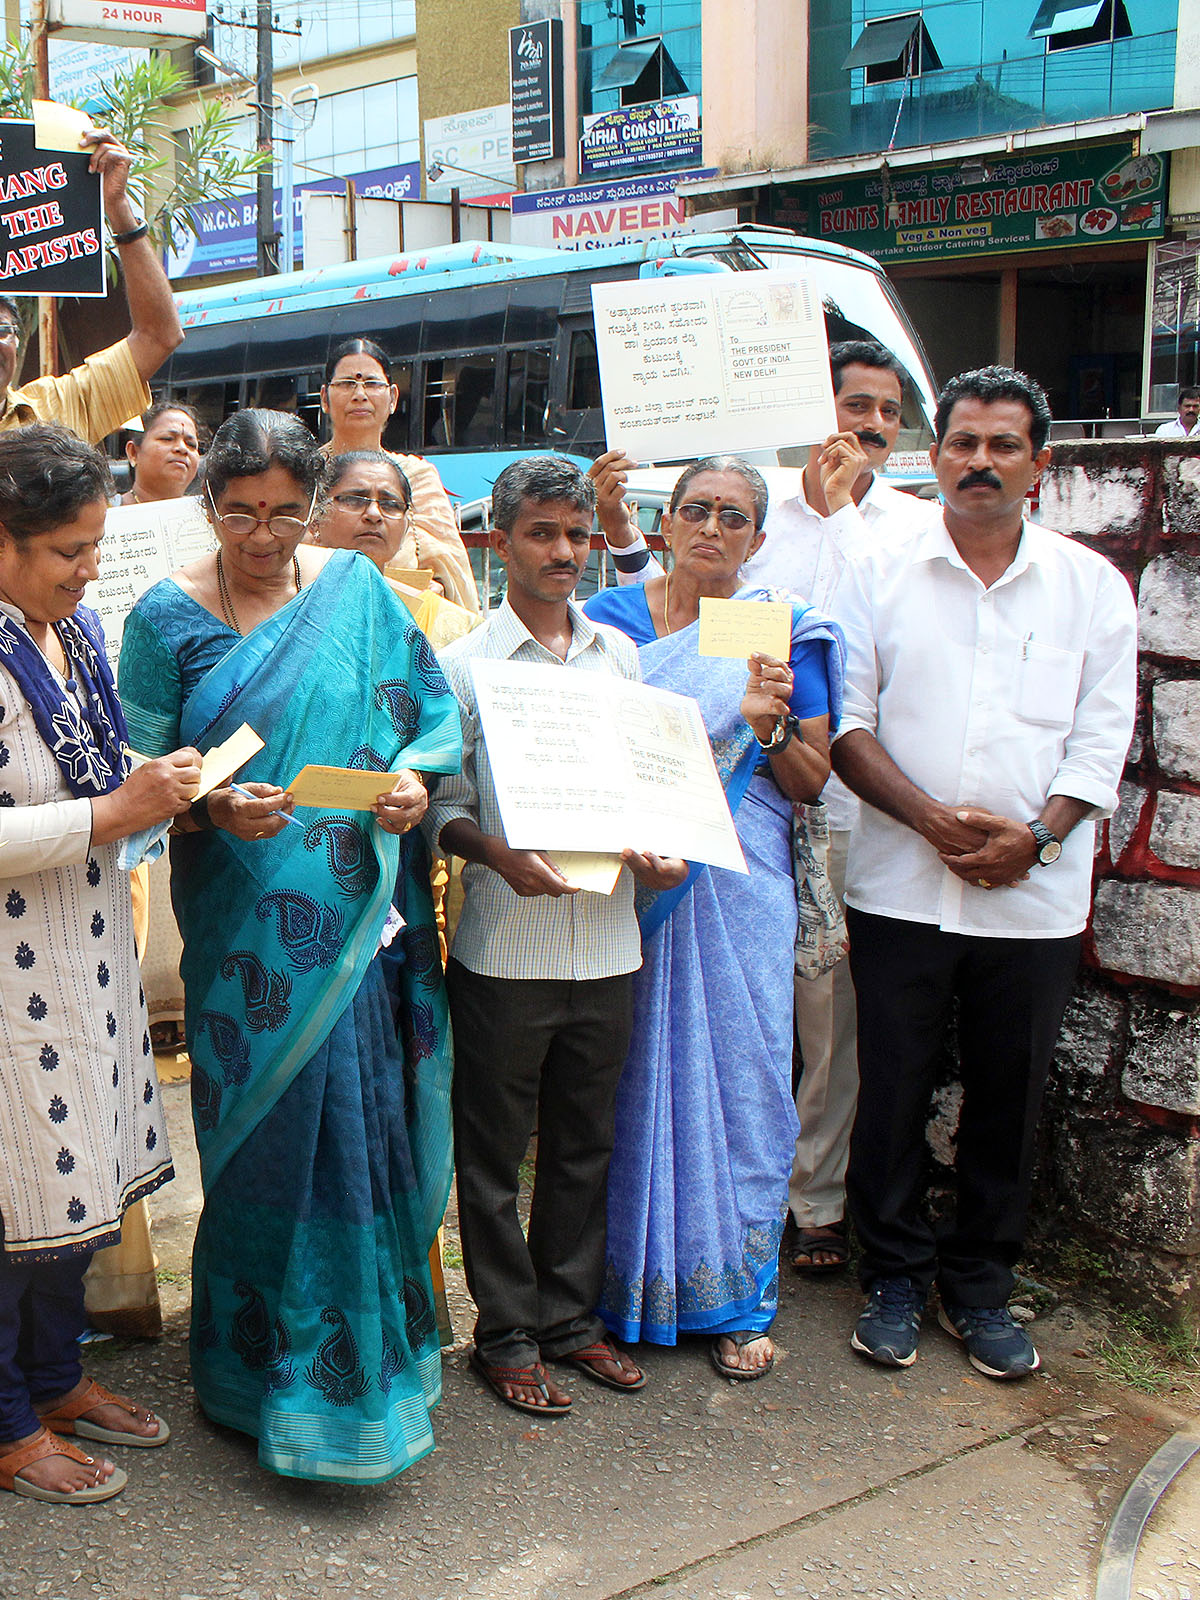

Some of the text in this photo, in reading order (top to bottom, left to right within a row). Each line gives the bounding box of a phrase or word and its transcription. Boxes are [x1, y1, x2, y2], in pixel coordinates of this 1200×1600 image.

[102, 8, 162, 23] 24 HOUR
[536, 194, 567, 209] ನವೀನ್
[568, 188, 604, 206] ಡಿಜಿಟಲ್
[818, 190, 843, 207] New
[203, 210, 241, 232] M.C.C.
[243, 198, 280, 226] BAK
[820, 205, 879, 235] BUNTS
[956, 179, 1094, 222] RESTAURANT
[1, 201, 64, 240] THE
[553, 199, 686, 240] NAVEEN
[901, 226, 987, 242] Veg & Non veg
[906, 242, 944, 253] Outdoor
[945, 238, 985, 249] Catering
[988, 234, 1030, 245] Services
[730, 335, 739, 345] To
[731, 342, 791, 355] THE PRESIDENT
[733, 354, 790, 367] GOVT. OF INDIA
[734, 367, 777, 380] NEW DELHI
[630, 748, 686, 767] THE PRESIDENT
[636, 772, 654, 782] NEW
[657, 765, 666, 774] OF
[669, 768, 688, 780] INDIA
